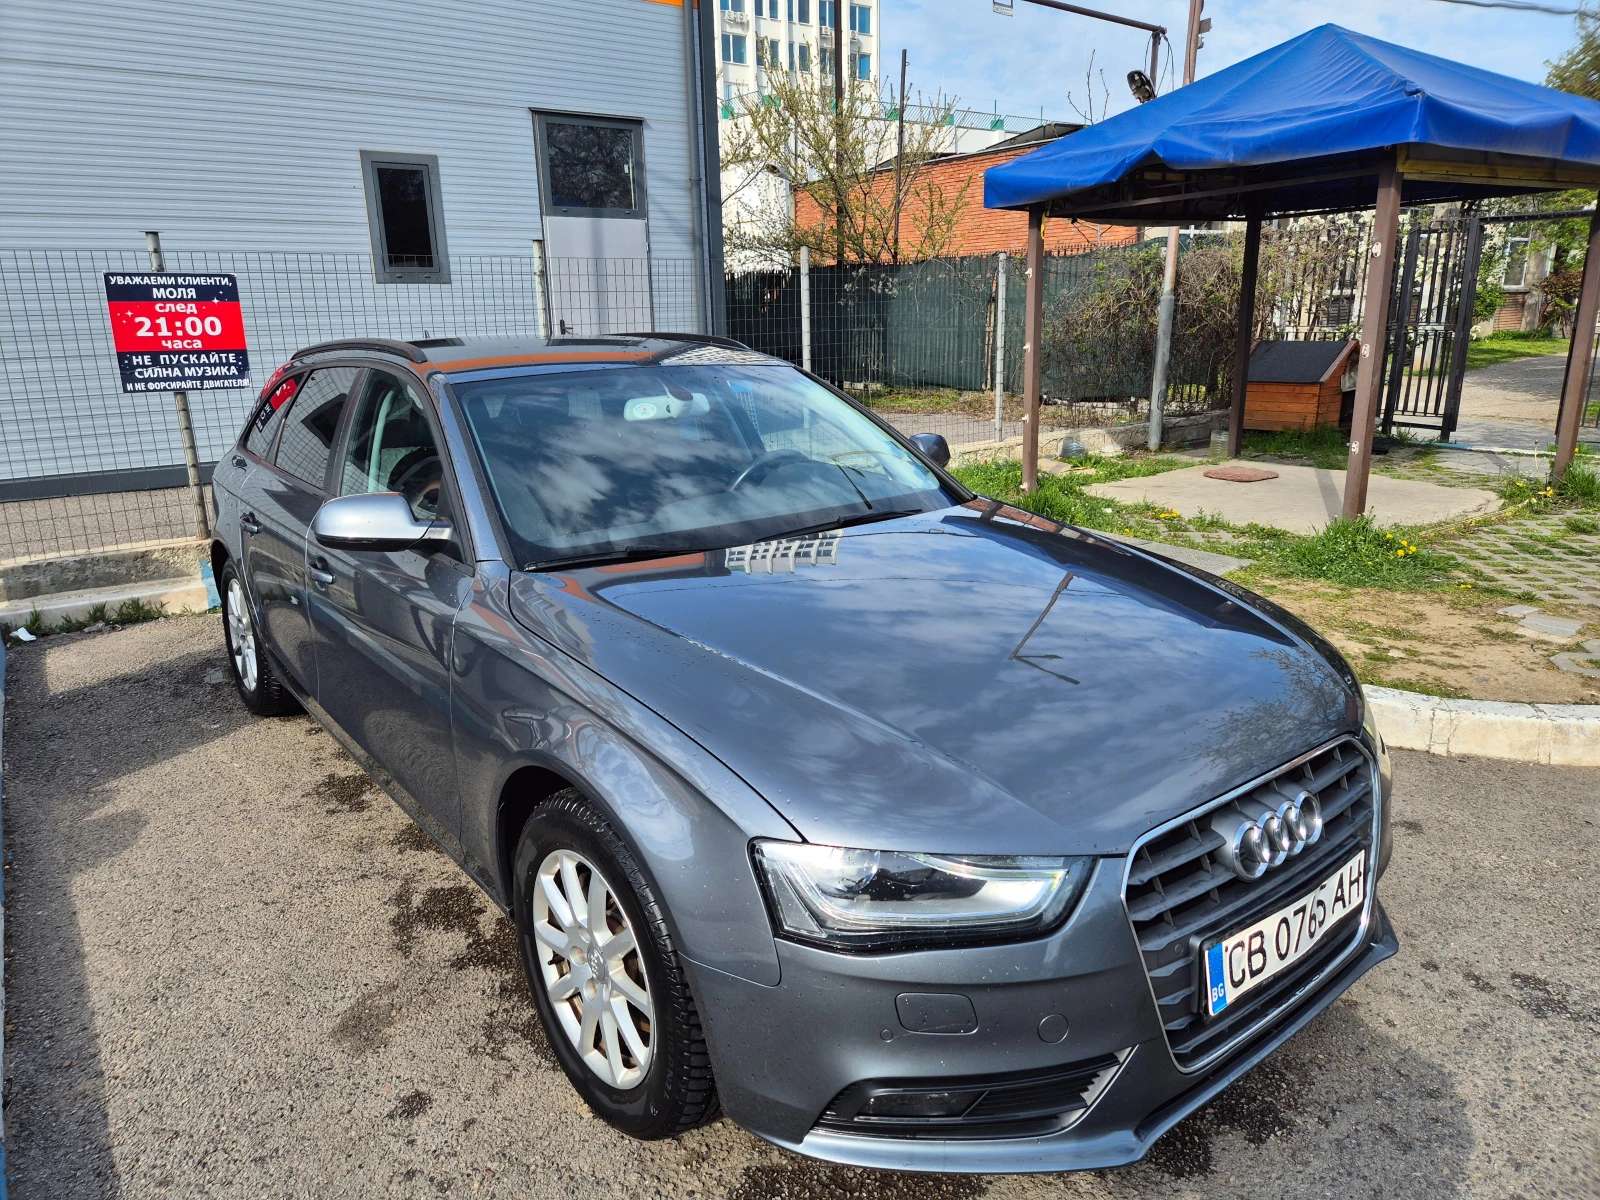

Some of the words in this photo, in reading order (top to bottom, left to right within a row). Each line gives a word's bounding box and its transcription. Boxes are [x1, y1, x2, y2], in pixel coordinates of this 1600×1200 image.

[109, 276, 176, 285] УВАЖАЕМИ
[177, 276, 233, 287] КЛИЕНТИ,
[152, 288, 197, 299] МОЛЯ
[155, 303, 198, 314] след
[134, 316, 222, 337] 21:00
[161, 339, 203, 349] часа
[132, 355, 152, 366] НЕ
[159, 352, 237, 365] ПУСКАЙТЕ
[134, 367, 182, 379] СИЛНА
[184, 365, 238, 377] МУЗИКА
[126, 382, 134, 391] И
[135, 382, 146, 391] НЕ
[147, 380, 202, 391] ФОРСИРАЙТЕ
[203, 378, 250, 390] ДВИГАТЕЛЯ!
[1228, 929, 1267, 989] CB
[1274, 882, 1327, 961] 0765
[1331, 858, 1362, 916] AH
[1211, 982, 1225, 1003] BG
